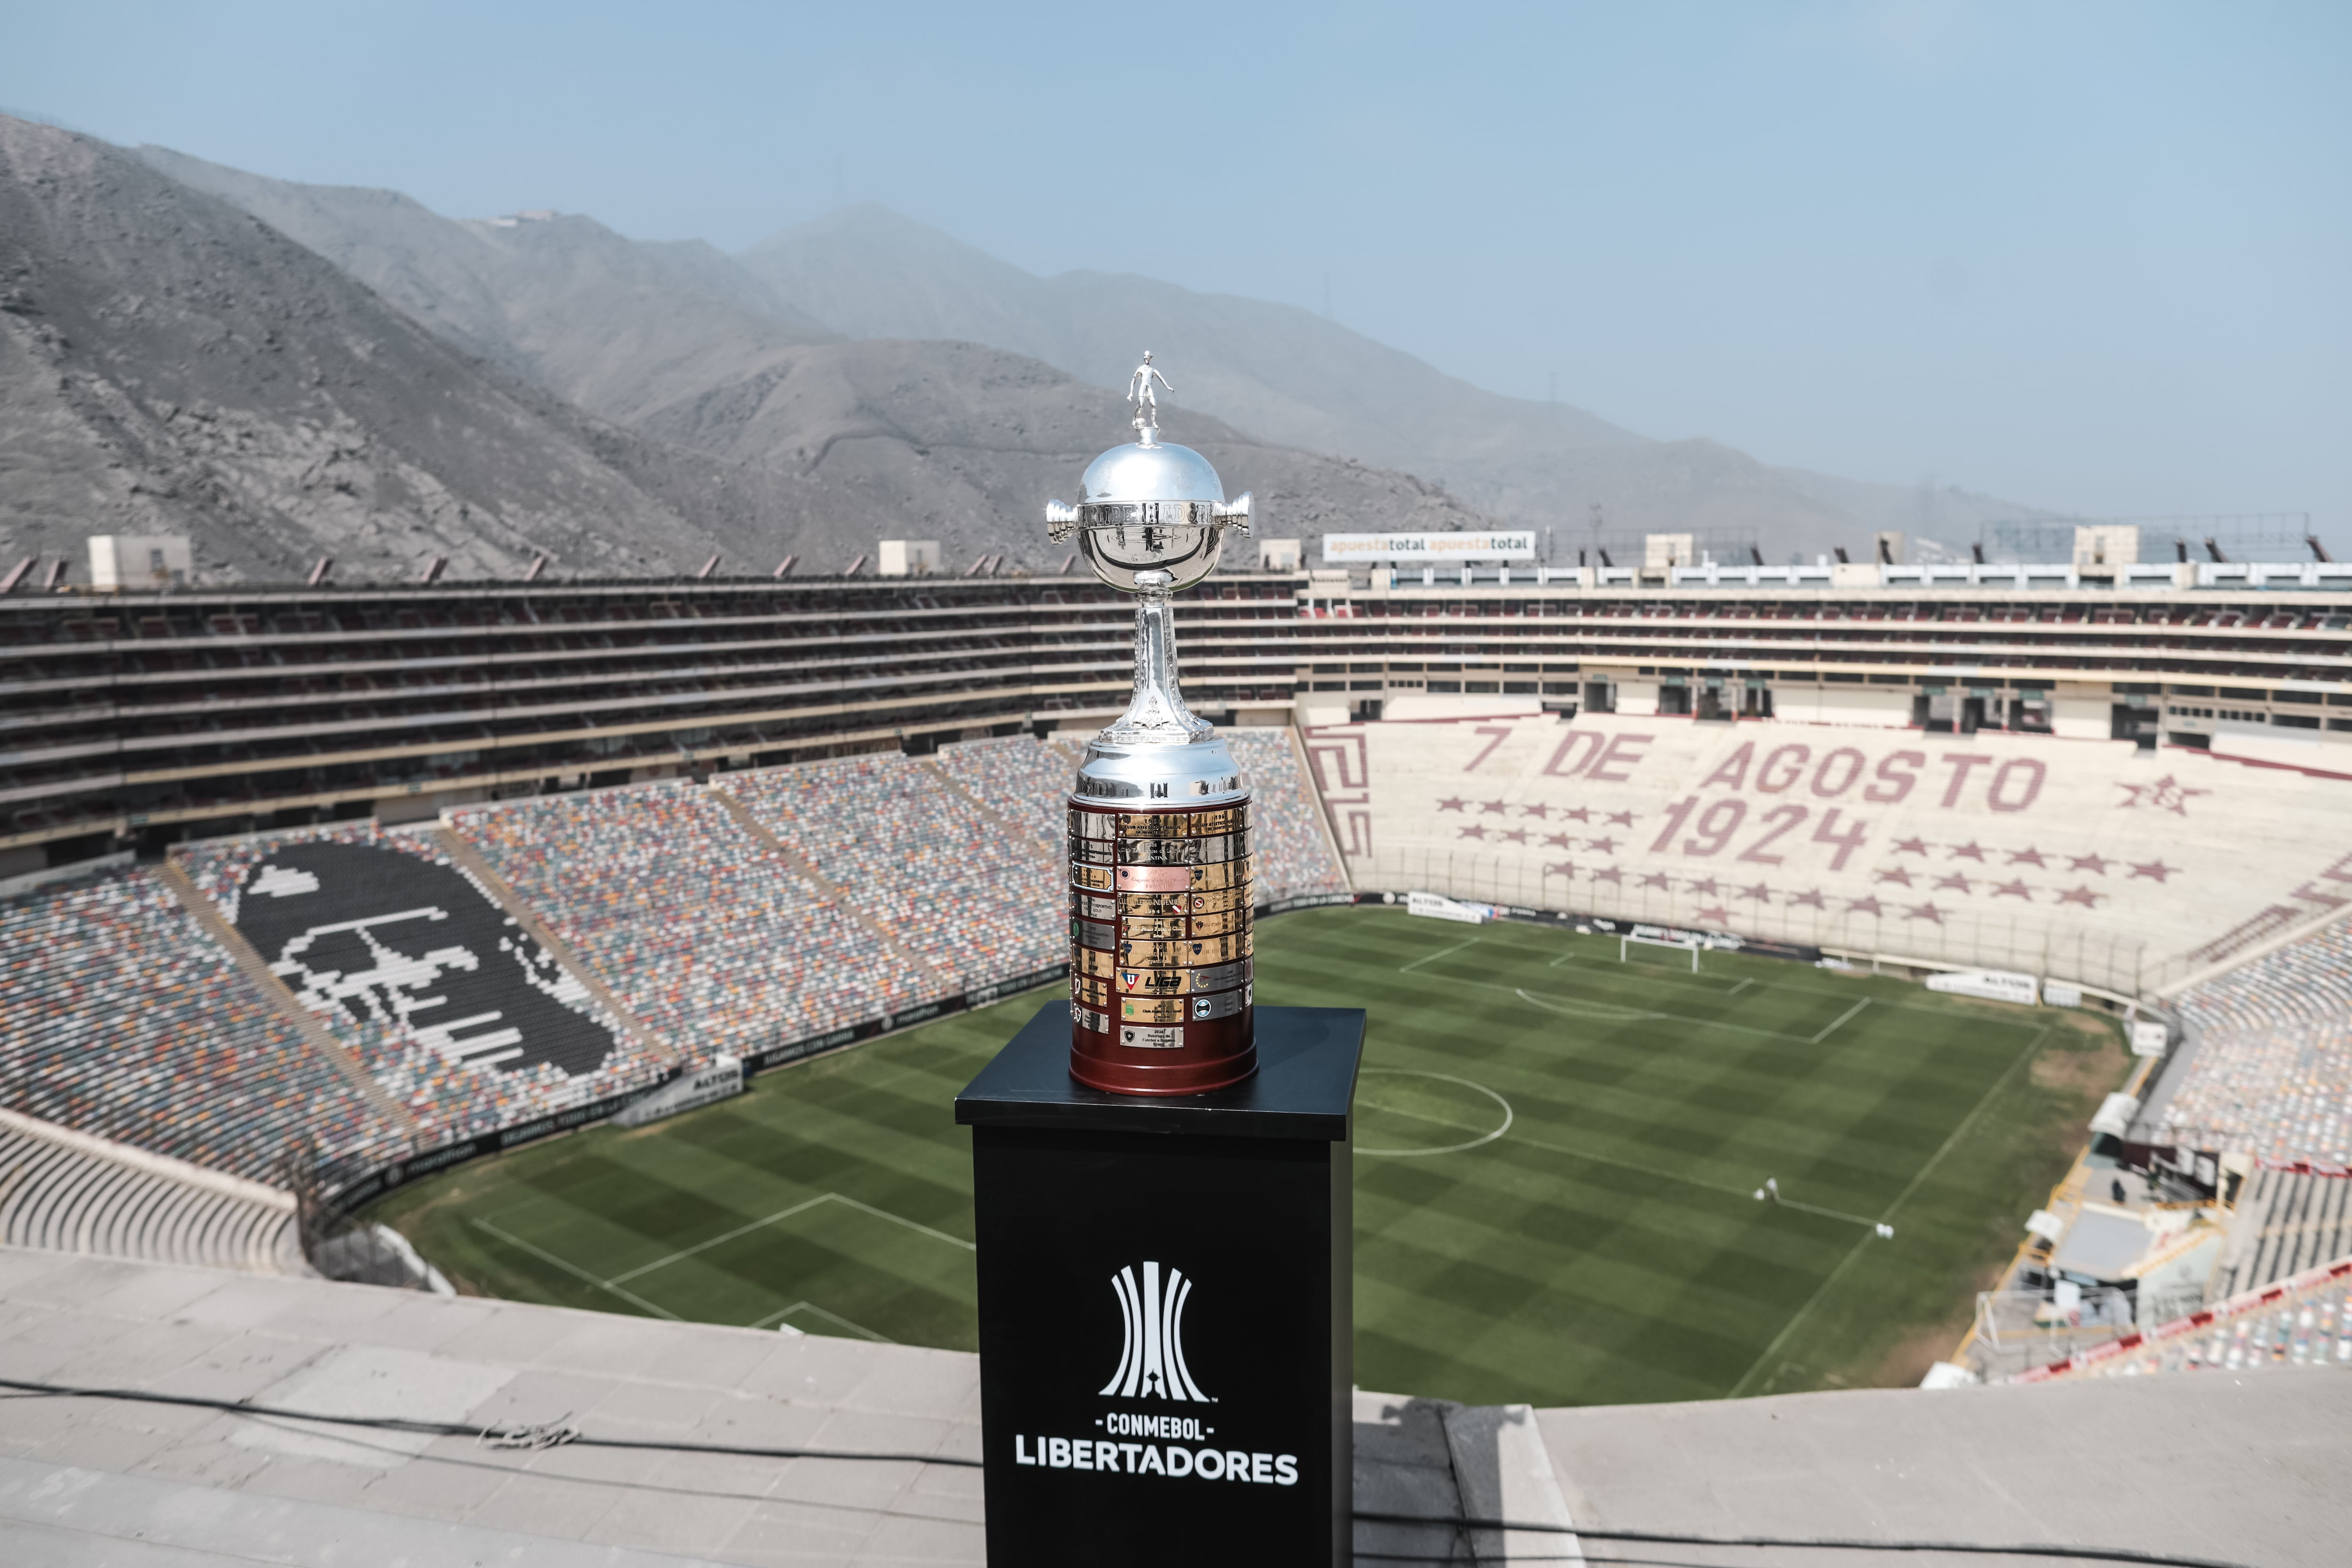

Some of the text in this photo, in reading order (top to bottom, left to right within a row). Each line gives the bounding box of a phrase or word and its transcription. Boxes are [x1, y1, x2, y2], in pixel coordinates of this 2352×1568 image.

[1097, 504, 1221, 525] LIBERTADORES
[1329, 536, 1528, 554] apuestatotal apuestatotal
[1463, 726, 2048, 812] 7 DE AGOSTO
[1649, 796, 1867, 871] 1924
[1127, 975, 1135, 985] U
[1106, 1413, 1205, 1441] CONMEBOL
[1015, 1434, 1298, 1486] LIBERTADORES
